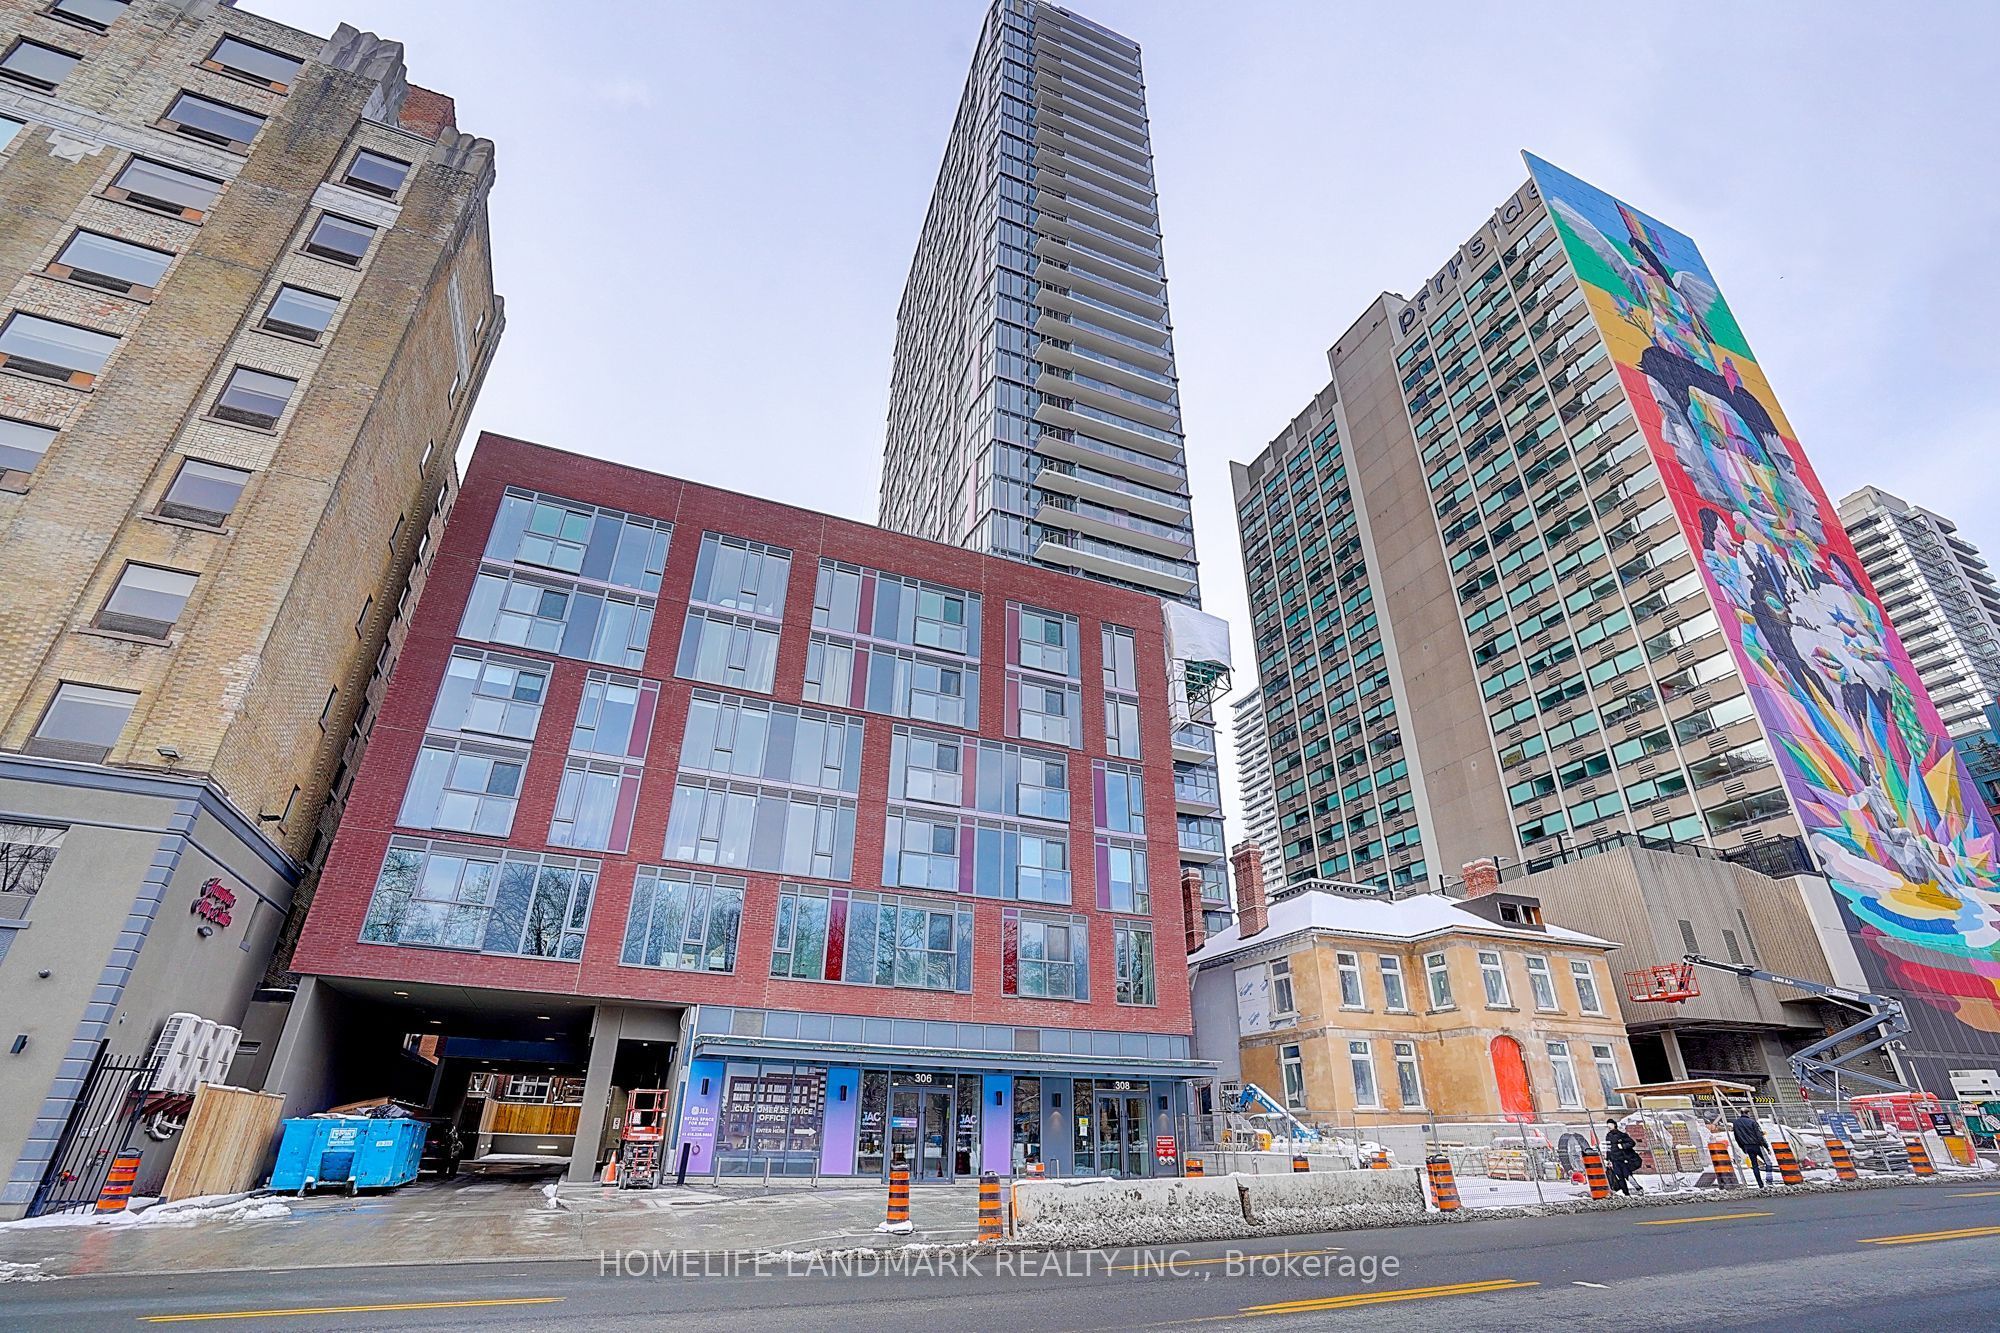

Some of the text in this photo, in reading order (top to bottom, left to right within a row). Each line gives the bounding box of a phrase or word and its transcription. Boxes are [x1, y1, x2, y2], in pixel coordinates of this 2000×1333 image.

[915, 1074, 932, 1083] 306
[1115, 1081, 1130, 1090] 308
[759, 1114, 786, 1122] OFFICE
[862, 1111, 881, 1122] JAC
[960, 1114, 977, 1124] JAC
